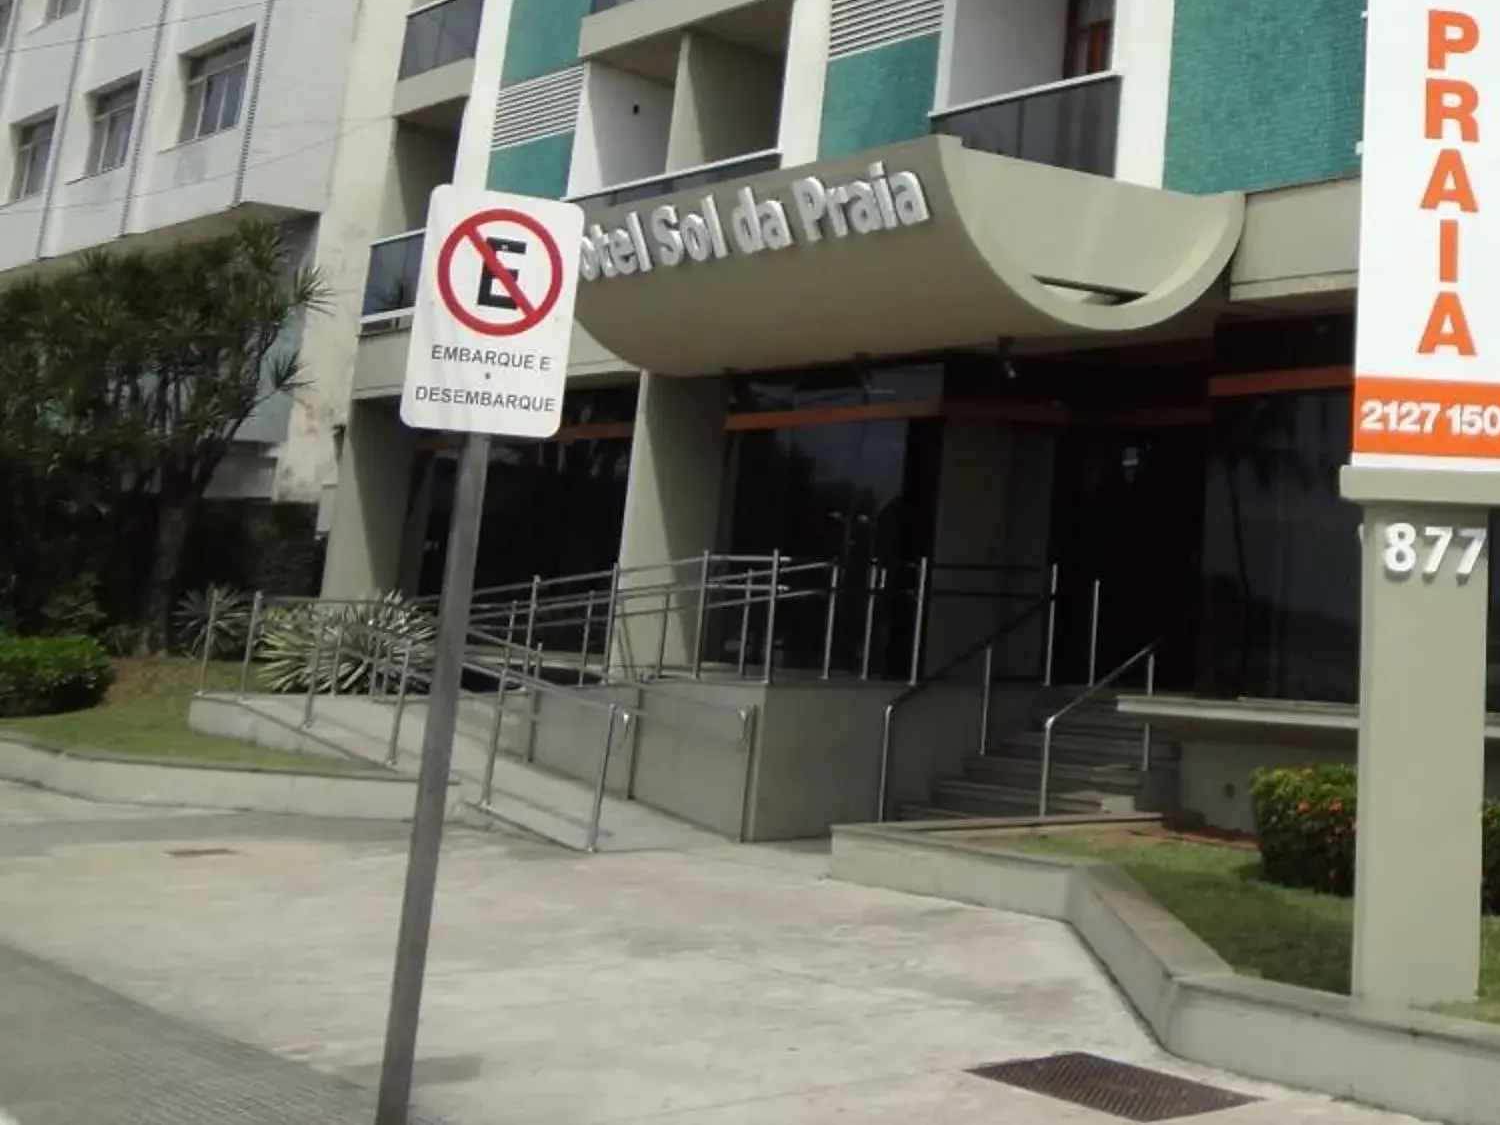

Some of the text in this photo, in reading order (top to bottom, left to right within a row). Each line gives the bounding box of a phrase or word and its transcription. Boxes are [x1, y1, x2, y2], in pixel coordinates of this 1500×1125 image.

[1418, 10, 1480, 356] PRAIA
[579, 160, 930, 281] otel Sol da Praia
[431, 344, 552, 372] EMBARQUE E
[415, 386, 556, 413] DESEMBARQUE
[1361, 400, 1440, 433] 2127
[1384, 522, 1487, 575] 877
